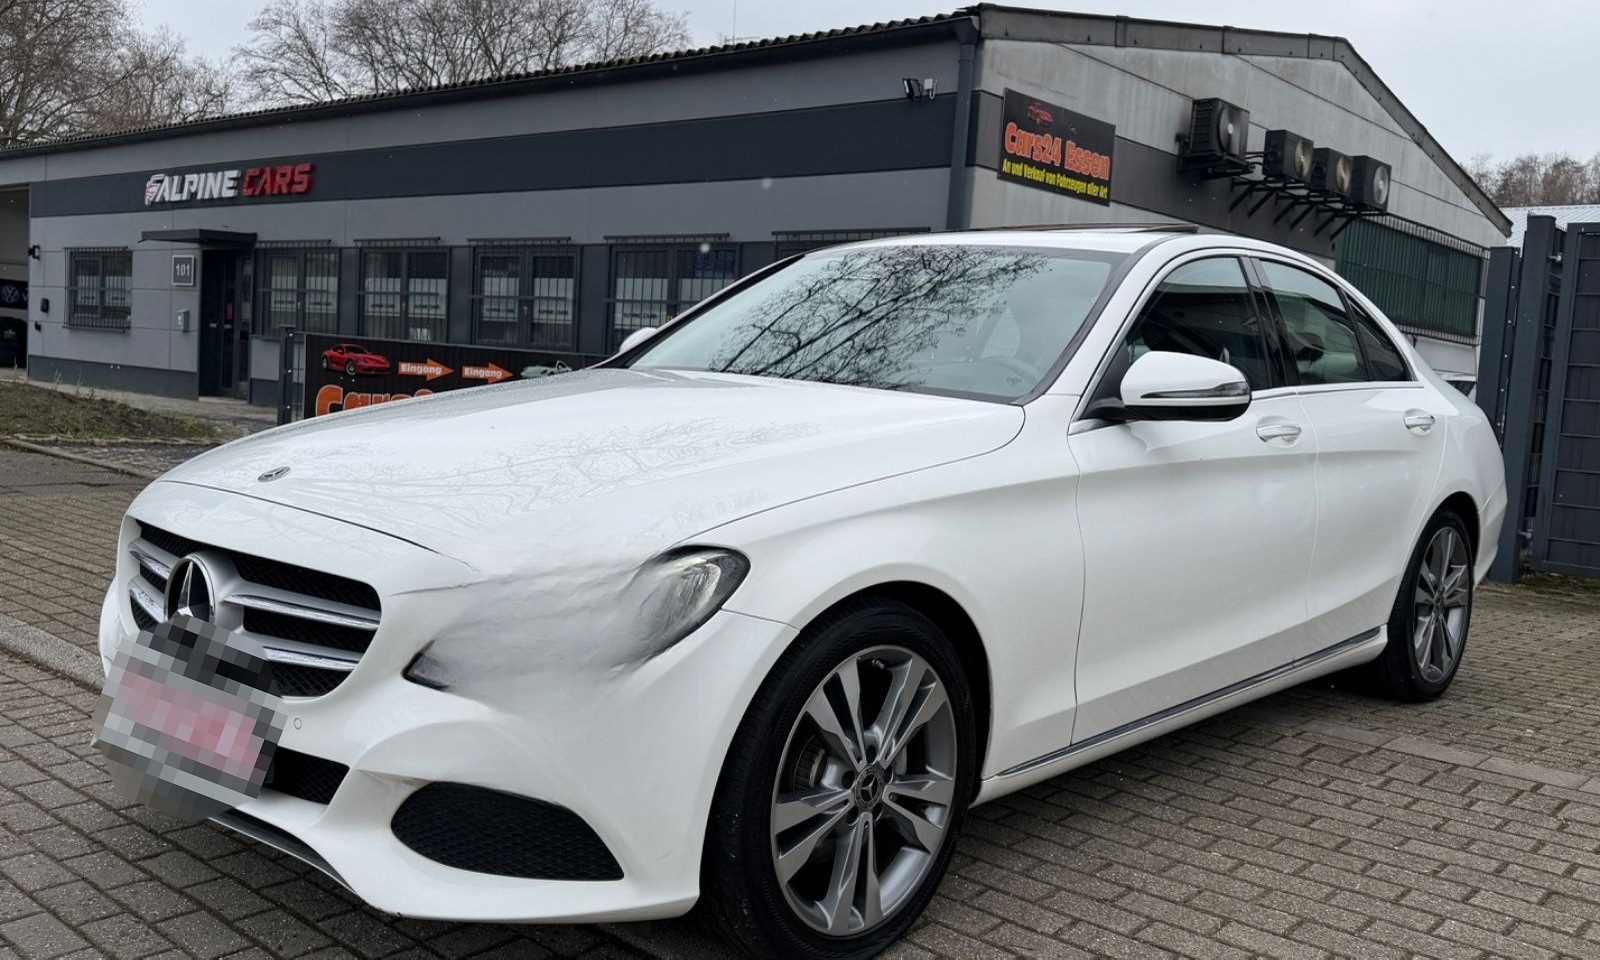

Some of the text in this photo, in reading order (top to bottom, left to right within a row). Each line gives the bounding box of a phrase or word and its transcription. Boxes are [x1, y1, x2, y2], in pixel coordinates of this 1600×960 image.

[1005, 122, 1110, 180] Cars24 Essen
[155, 163, 313, 202] ALPINE CARS
[175, 263, 191, 277] 101
[400, 362, 442, 376] Eingang
[464, 367, 503, 380] Eingang
